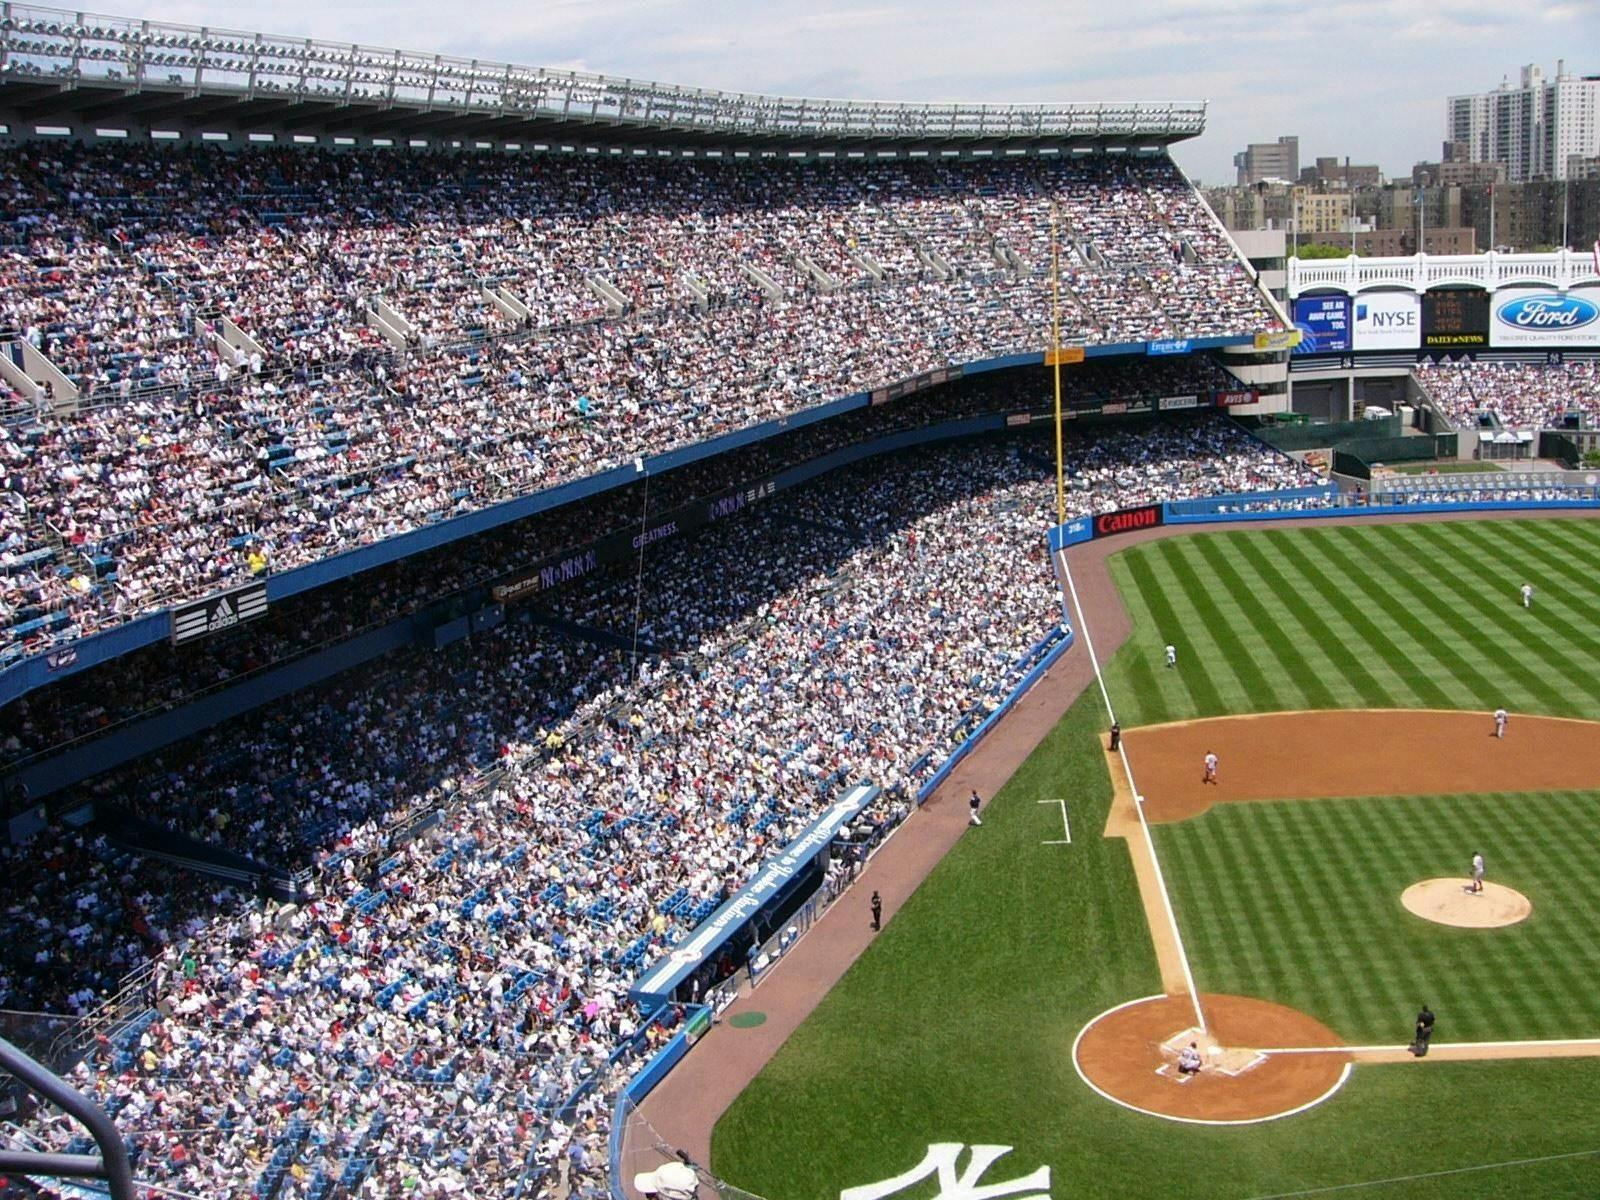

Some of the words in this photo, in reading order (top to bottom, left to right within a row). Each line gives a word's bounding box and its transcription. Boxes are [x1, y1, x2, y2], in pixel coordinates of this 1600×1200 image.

[1373, 311, 1416, 327] NYSE
[1516, 300, 1579, 325] Ford
[1426, 335, 1451, 345] DAILY
[1458, 335, 1484, 344] NEWS
[1098, 508, 1156, 533] Canon
[632, 520, 676, 549] GREATNESS
[208, 613, 238, 631] adidas
[714, 892, 759, 928] Stadium
